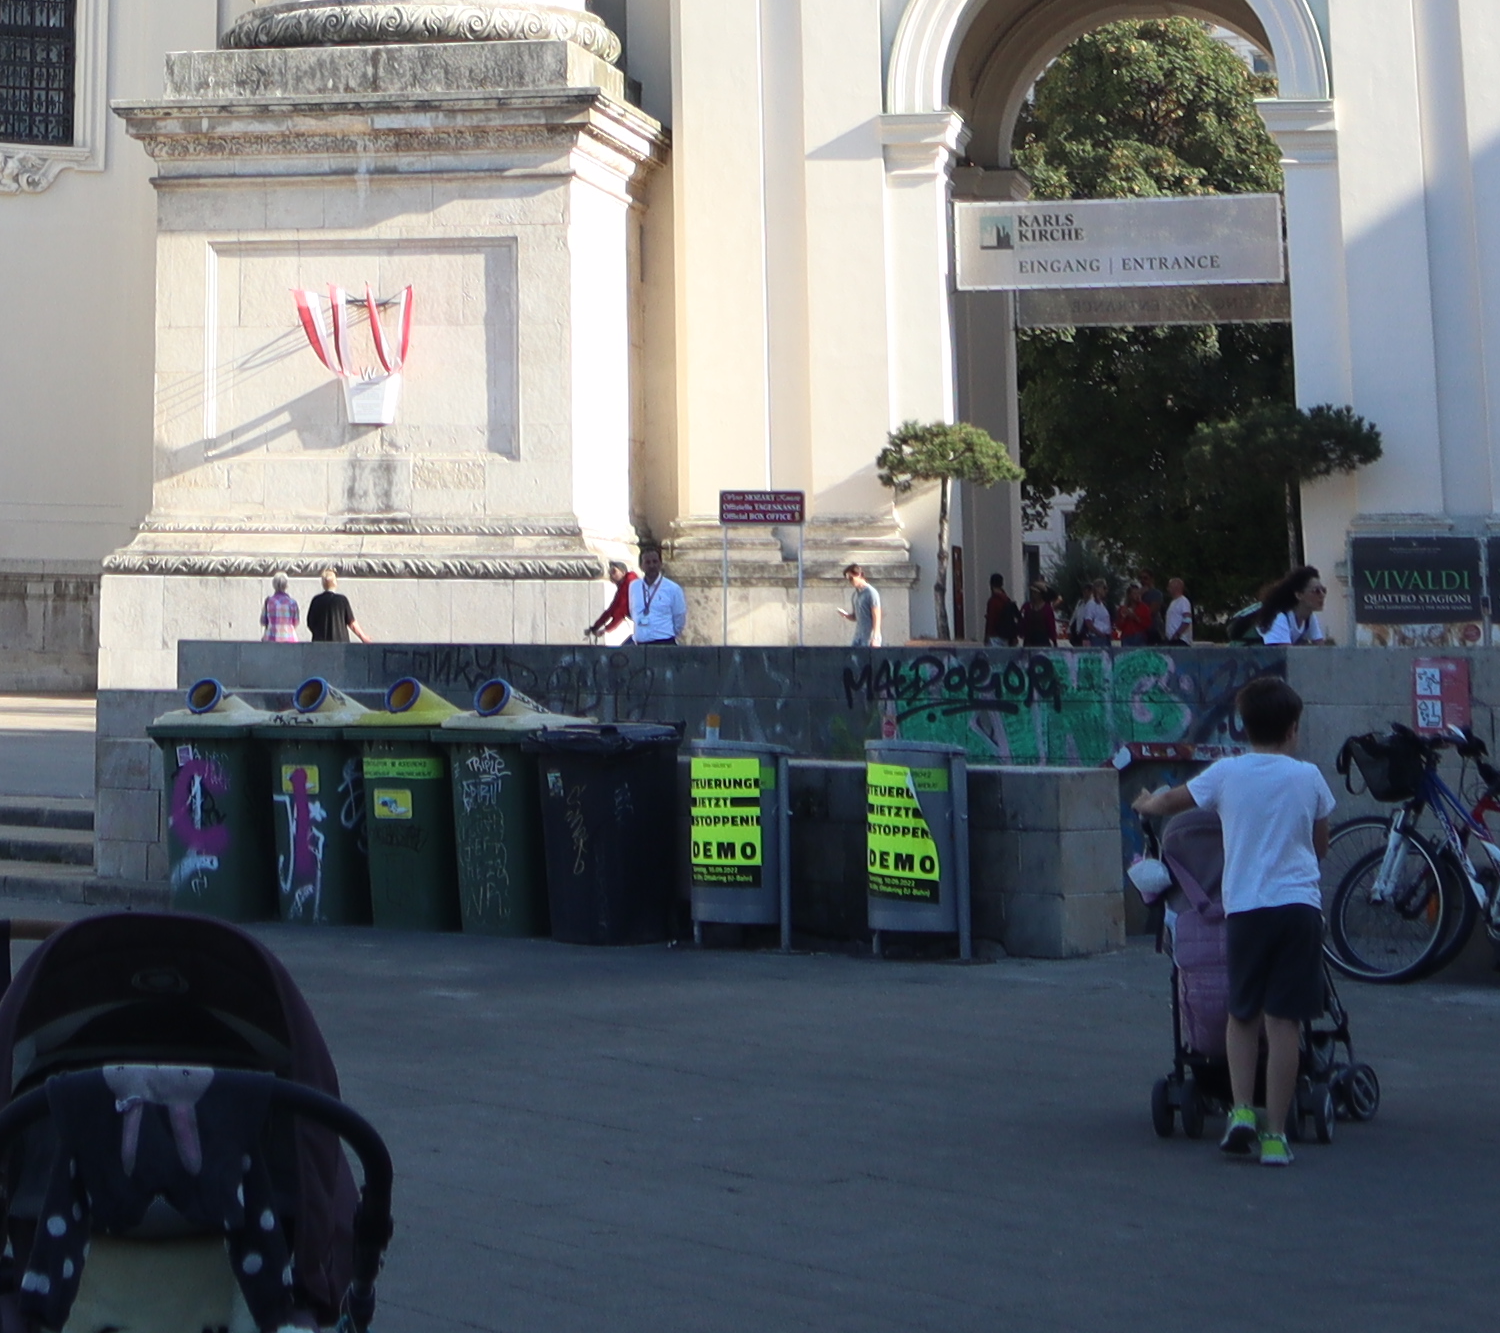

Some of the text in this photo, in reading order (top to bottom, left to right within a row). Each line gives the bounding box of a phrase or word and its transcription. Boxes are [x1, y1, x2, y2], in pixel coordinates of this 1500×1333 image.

[1017, 213, 1075, 228] KARLS
[1018, 227, 1085, 242] KIRCHE
[1019, 254, 1221, 275] EINGANG ENTRANCE
[1363, 569, 1471, 590] VIVALDI
[1363, 593, 1472, 605] QUATTRO STAGIONI
[876, 805, 911, 819] JETZT
[694, 816, 755, 827] STOPPEN!
[693, 841, 757, 860] DEMO
[869, 848, 936, 874] DEMO
